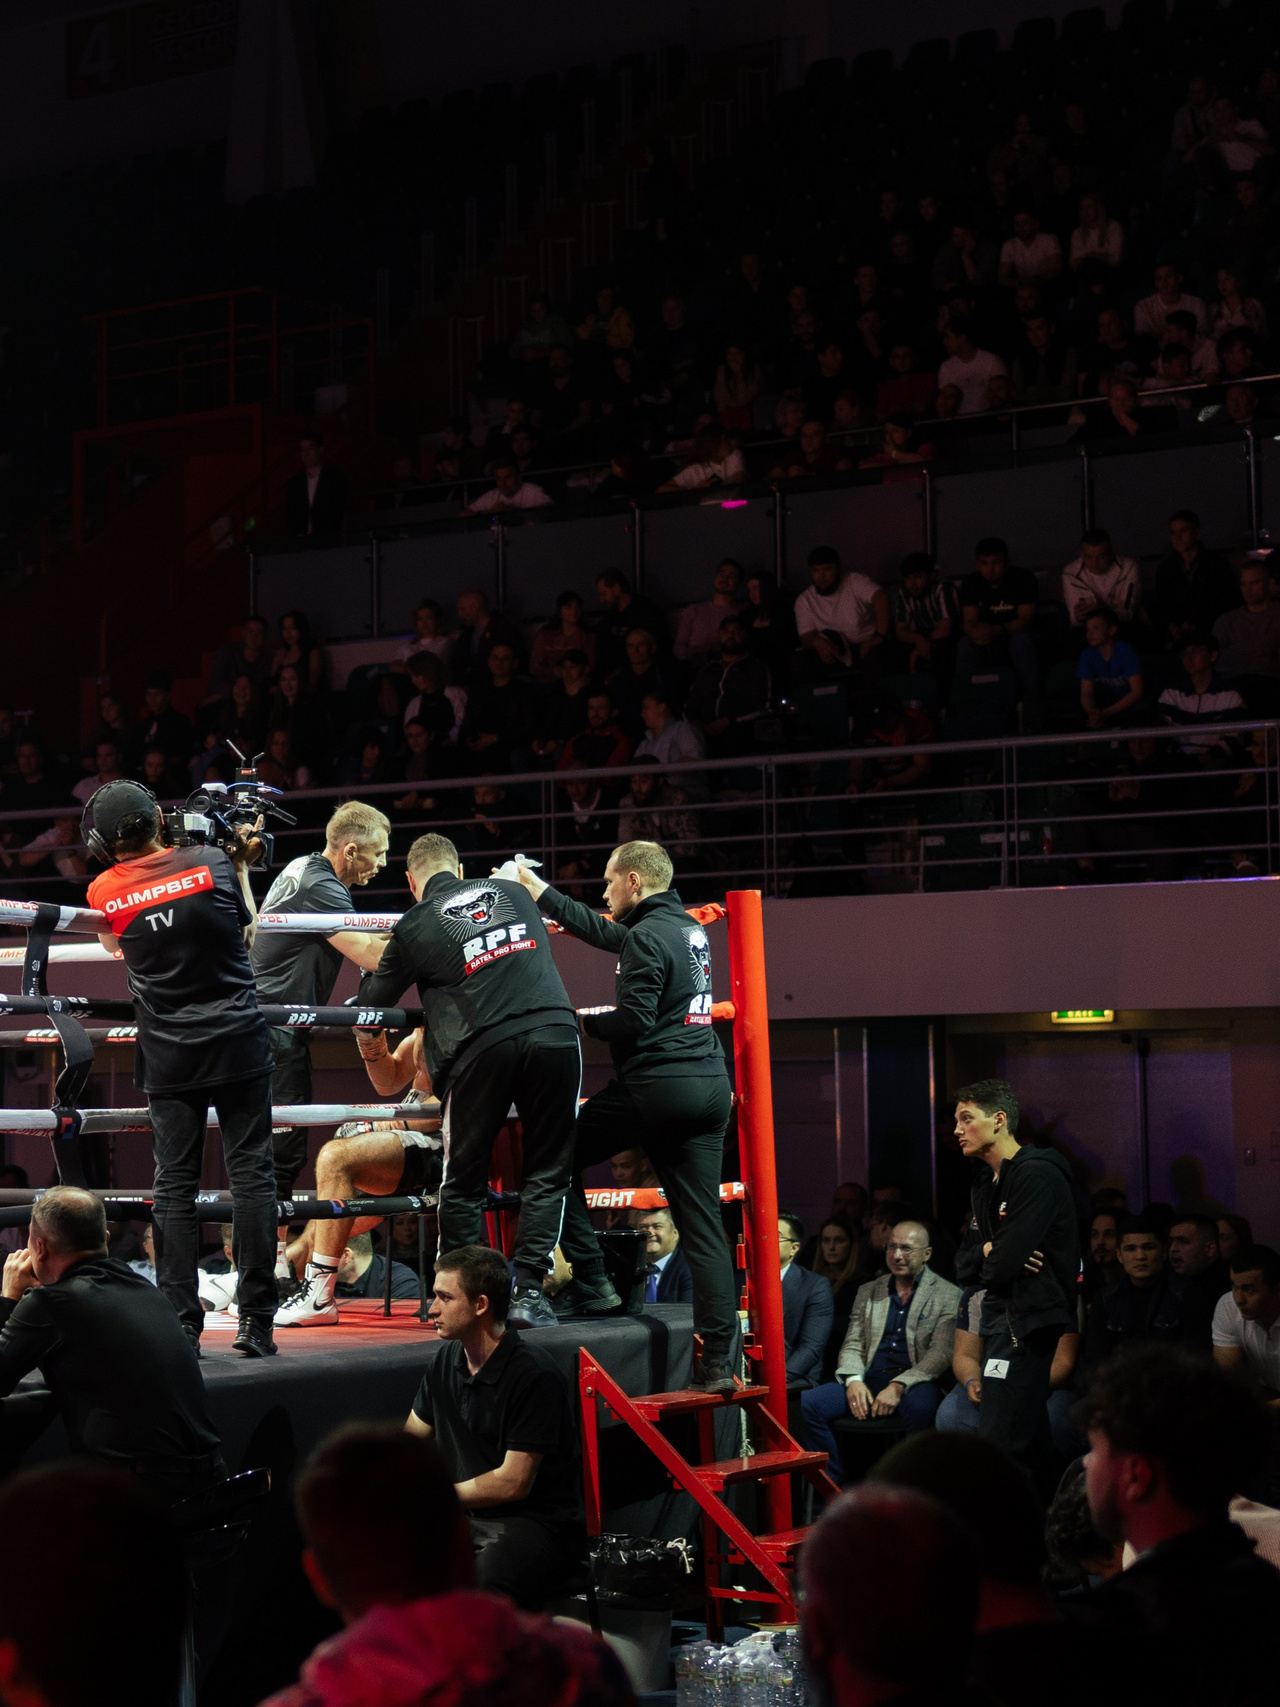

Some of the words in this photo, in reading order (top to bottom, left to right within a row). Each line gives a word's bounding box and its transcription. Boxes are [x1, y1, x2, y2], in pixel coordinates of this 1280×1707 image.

[105, 871, 207, 914] OLIMPBET
[145, 908, 174, 932] TV
[462, 923, 527, 964] RPF
[470, 953, 494, 970] RATEL
[494, 946, 510, 957] PRO
[510, 941, 532, 950] FIGHT
[286, 1012, 317, 1025] RPF
[356, 1011, 384, 1025] RPF
[585, 1190, 636, 1208] FIGHT
